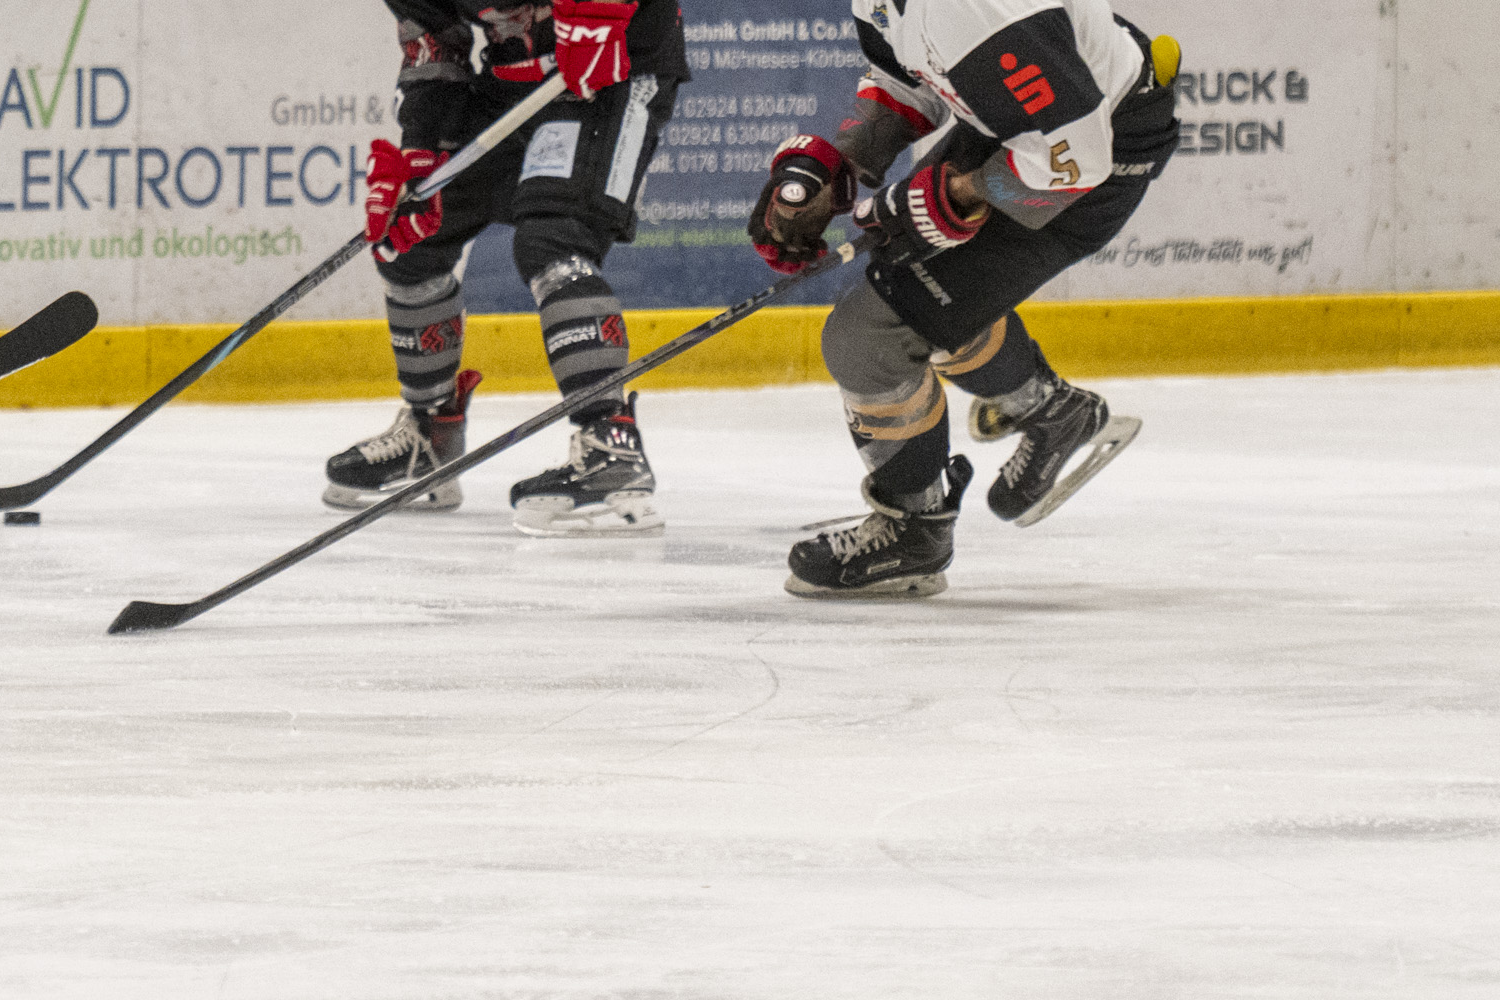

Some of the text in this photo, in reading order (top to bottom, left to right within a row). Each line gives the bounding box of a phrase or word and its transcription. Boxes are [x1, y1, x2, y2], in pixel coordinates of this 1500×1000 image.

[739, 18, 795, 42] GmbH
[796, 19, 810, 41] &
[1174, 69, 1309, 104] RUCK &
[270, 93, 385, 126] GmbH &
[1174, 118, 1285, 157] ESIGN
[1050, 139, 1081, 187] 5
[89, 226, 145, 259] und
[152, 224, 300, 266] ökologisch
